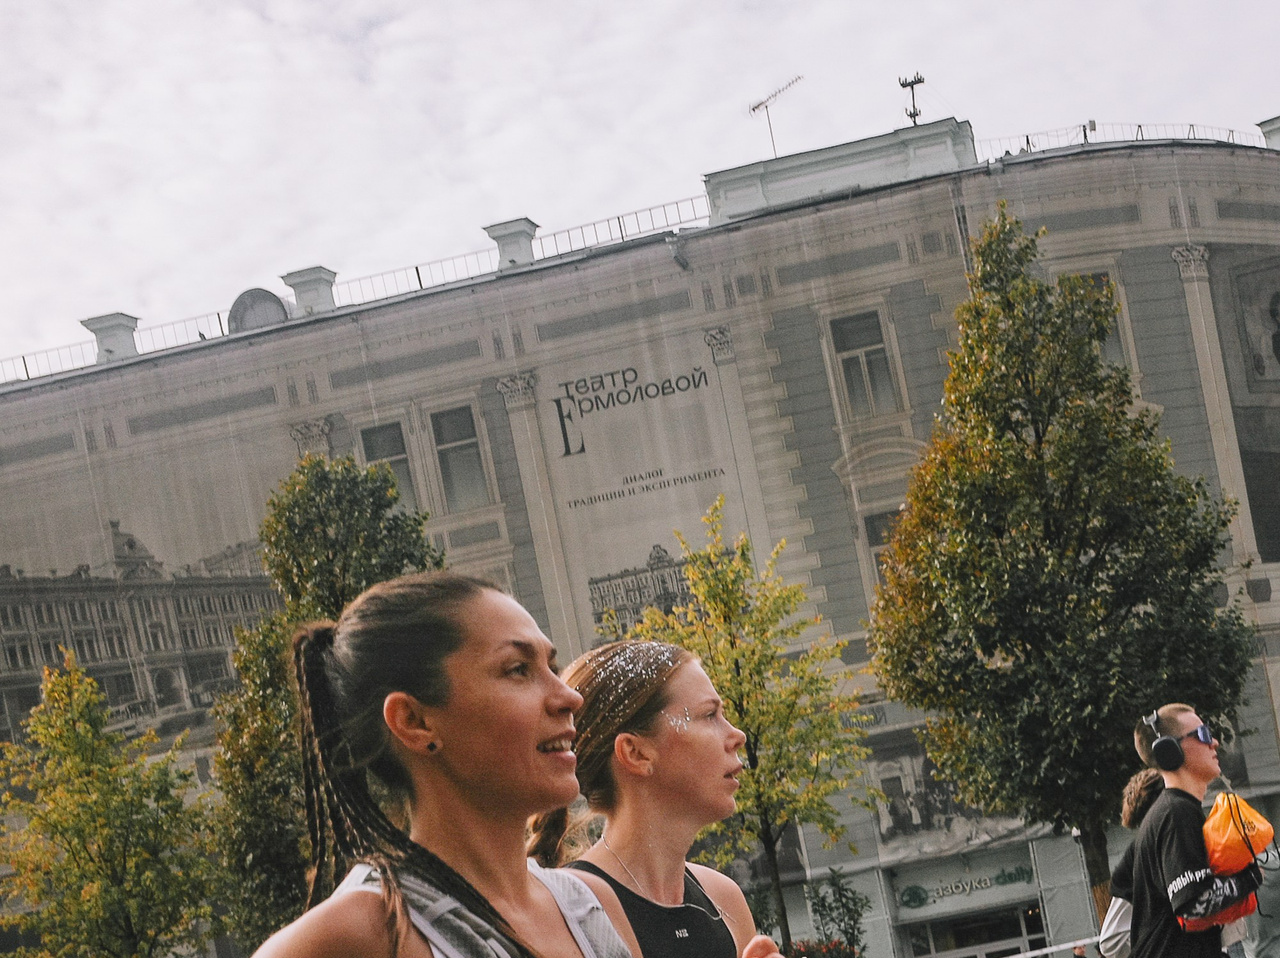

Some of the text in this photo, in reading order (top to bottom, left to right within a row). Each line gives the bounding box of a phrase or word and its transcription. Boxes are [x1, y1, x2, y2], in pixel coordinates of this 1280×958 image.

[622, 468, 664, 485] ДИАЛОГ
[567, 467, 726, 509] ТРАДИЦИИ И ЭКСПЕРИМЕНТА
[934, 876, 991, 898] азбука
